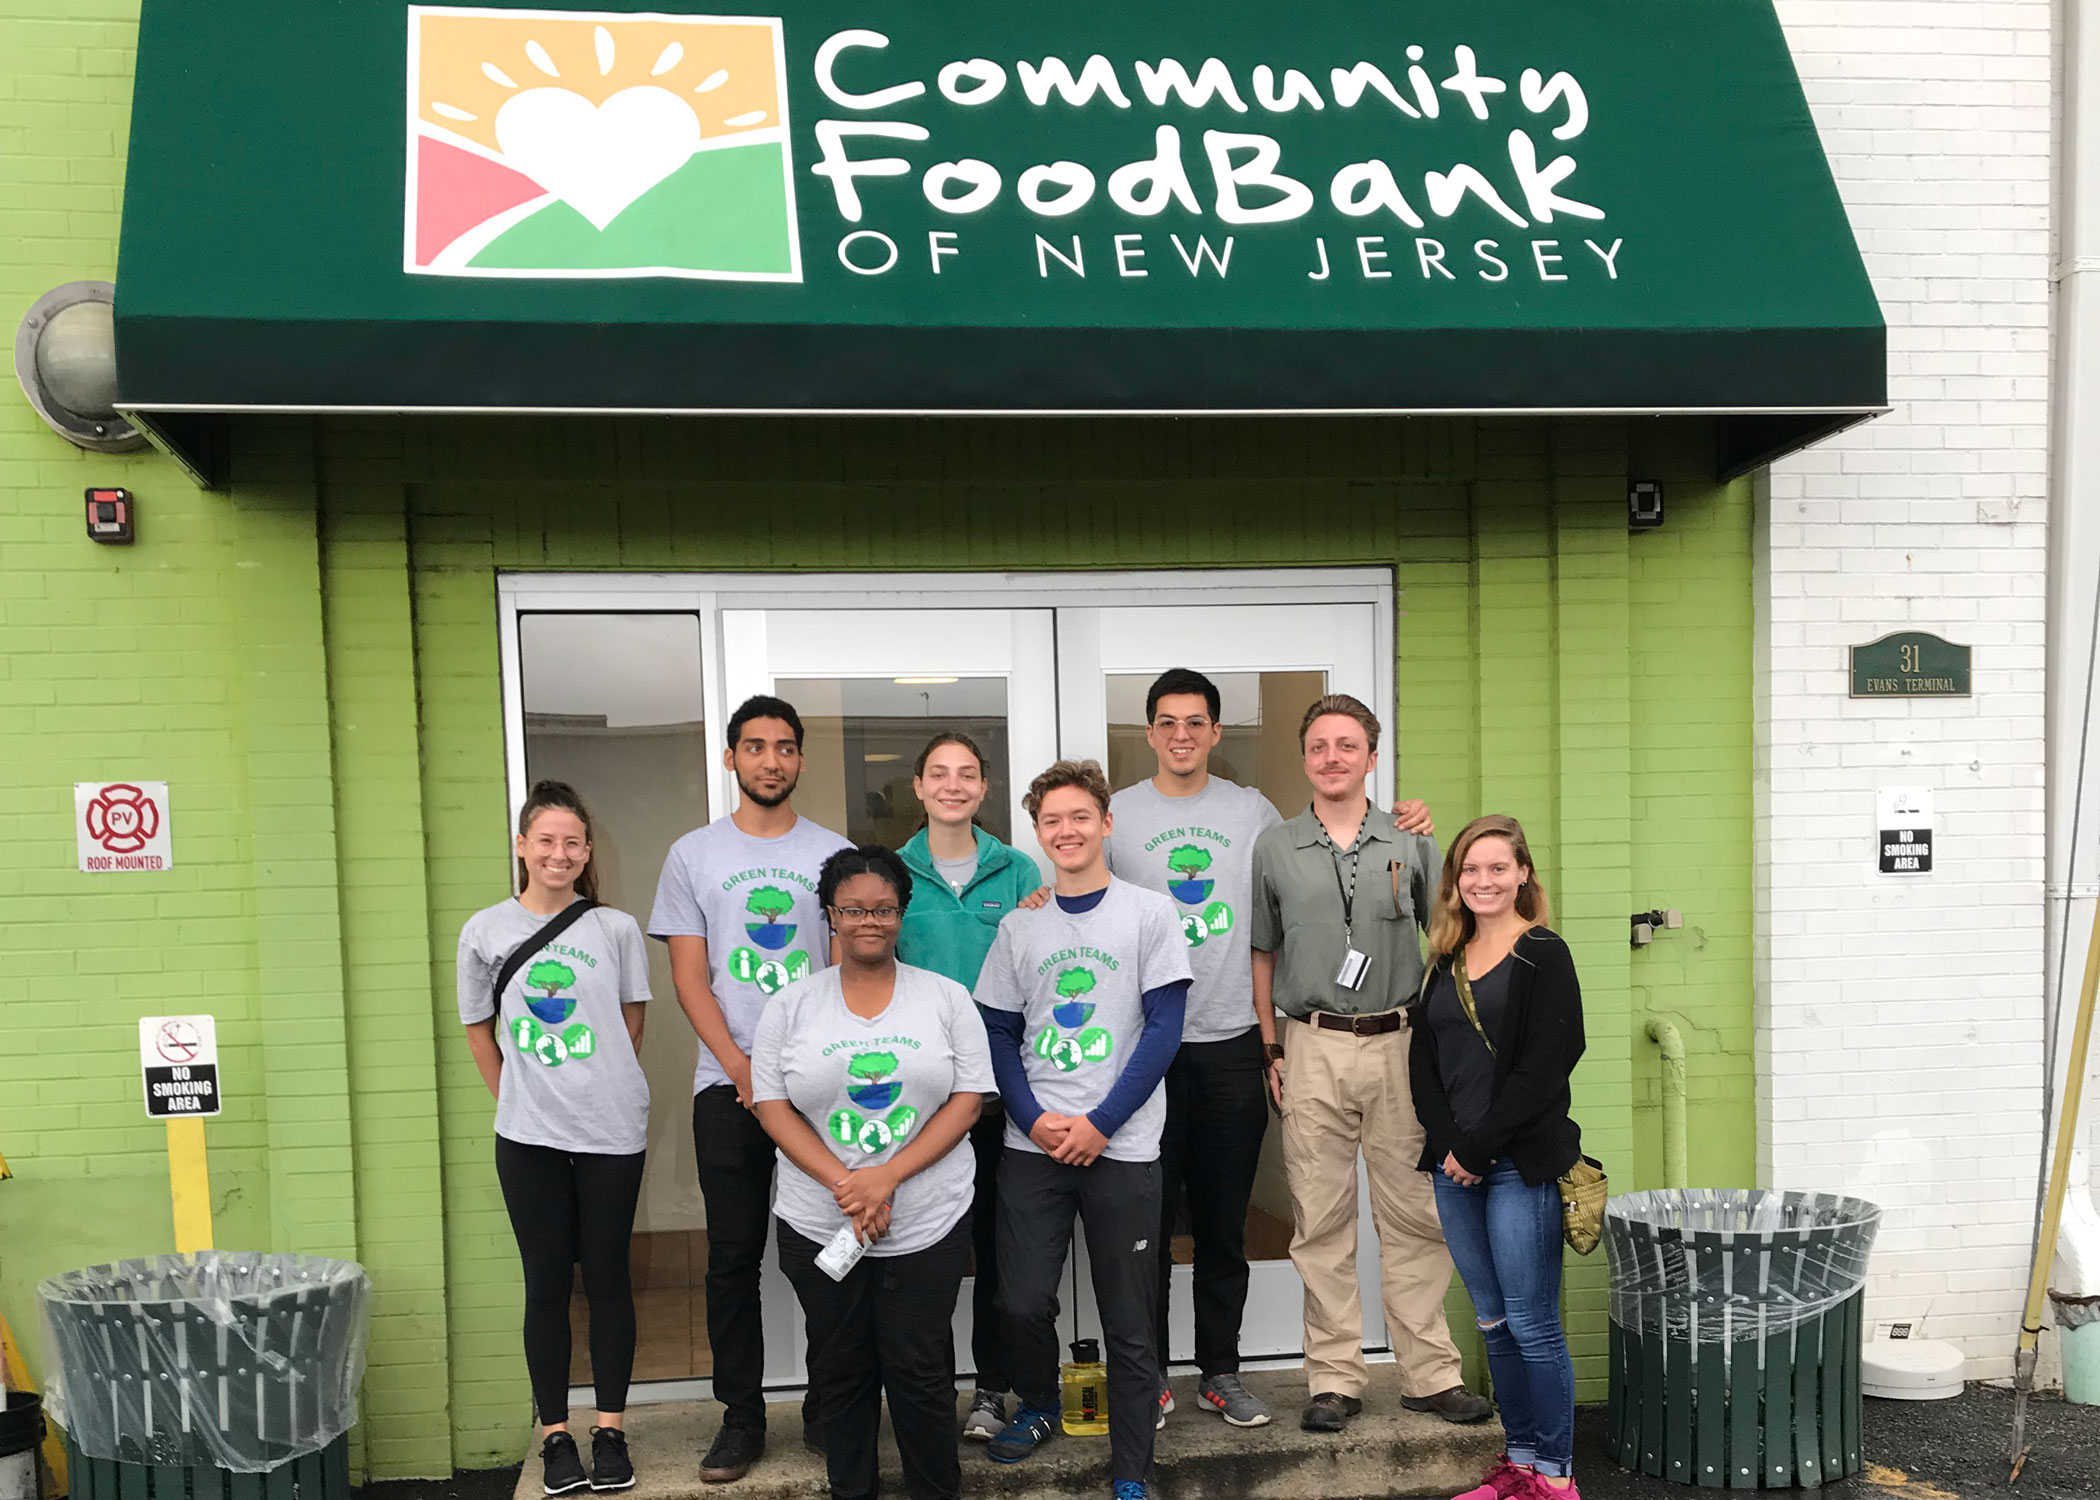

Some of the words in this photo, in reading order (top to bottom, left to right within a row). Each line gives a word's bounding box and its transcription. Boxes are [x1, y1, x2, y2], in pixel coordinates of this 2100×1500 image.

[813, 29, 1590, 141] Community
[810, 119, 1606, 229] FoodBank
[836, 230, 960, 277] OF
[1034, 232, 1235, 280] NEW
[1307, 236, 1624, 283] JERSEY
[1899, 644, 1921, 673] 31
[1866, 678, 1899, 692] EVANS
[1905, 677, 1956, 692] TERMINAL
[111, 811, 133, 826] PV
[1144, 827, 1186, 852] GREEN
[1188, 826, 1232, 848] TEAMS
[1898, 830, 1914, 843] NO
[1883, 843, 1929, 857] SMOKING
[87, 856, 112, 870] ROOF
[115, 855, 163, 870] MOUNTED
[1893, 857, 1920, 870] AREA
[722, 868, 767, 892] GREEN
[770, 868, 816, 893] TEAMS
[552, 943, 598, 969] TEAMS
[1037, 947, 1077, 976] GREEN
[1079, 946, 1120, 971] TEAMS
[822, 1039, 870, 1057] GREEN
[873, 1035, 922, 1050] TEAMS
[171, 1066, 191, 1081] NO
[152, 1080, 213, 1097] SMOKING
[167, 1095, 202, 1111] AREA
